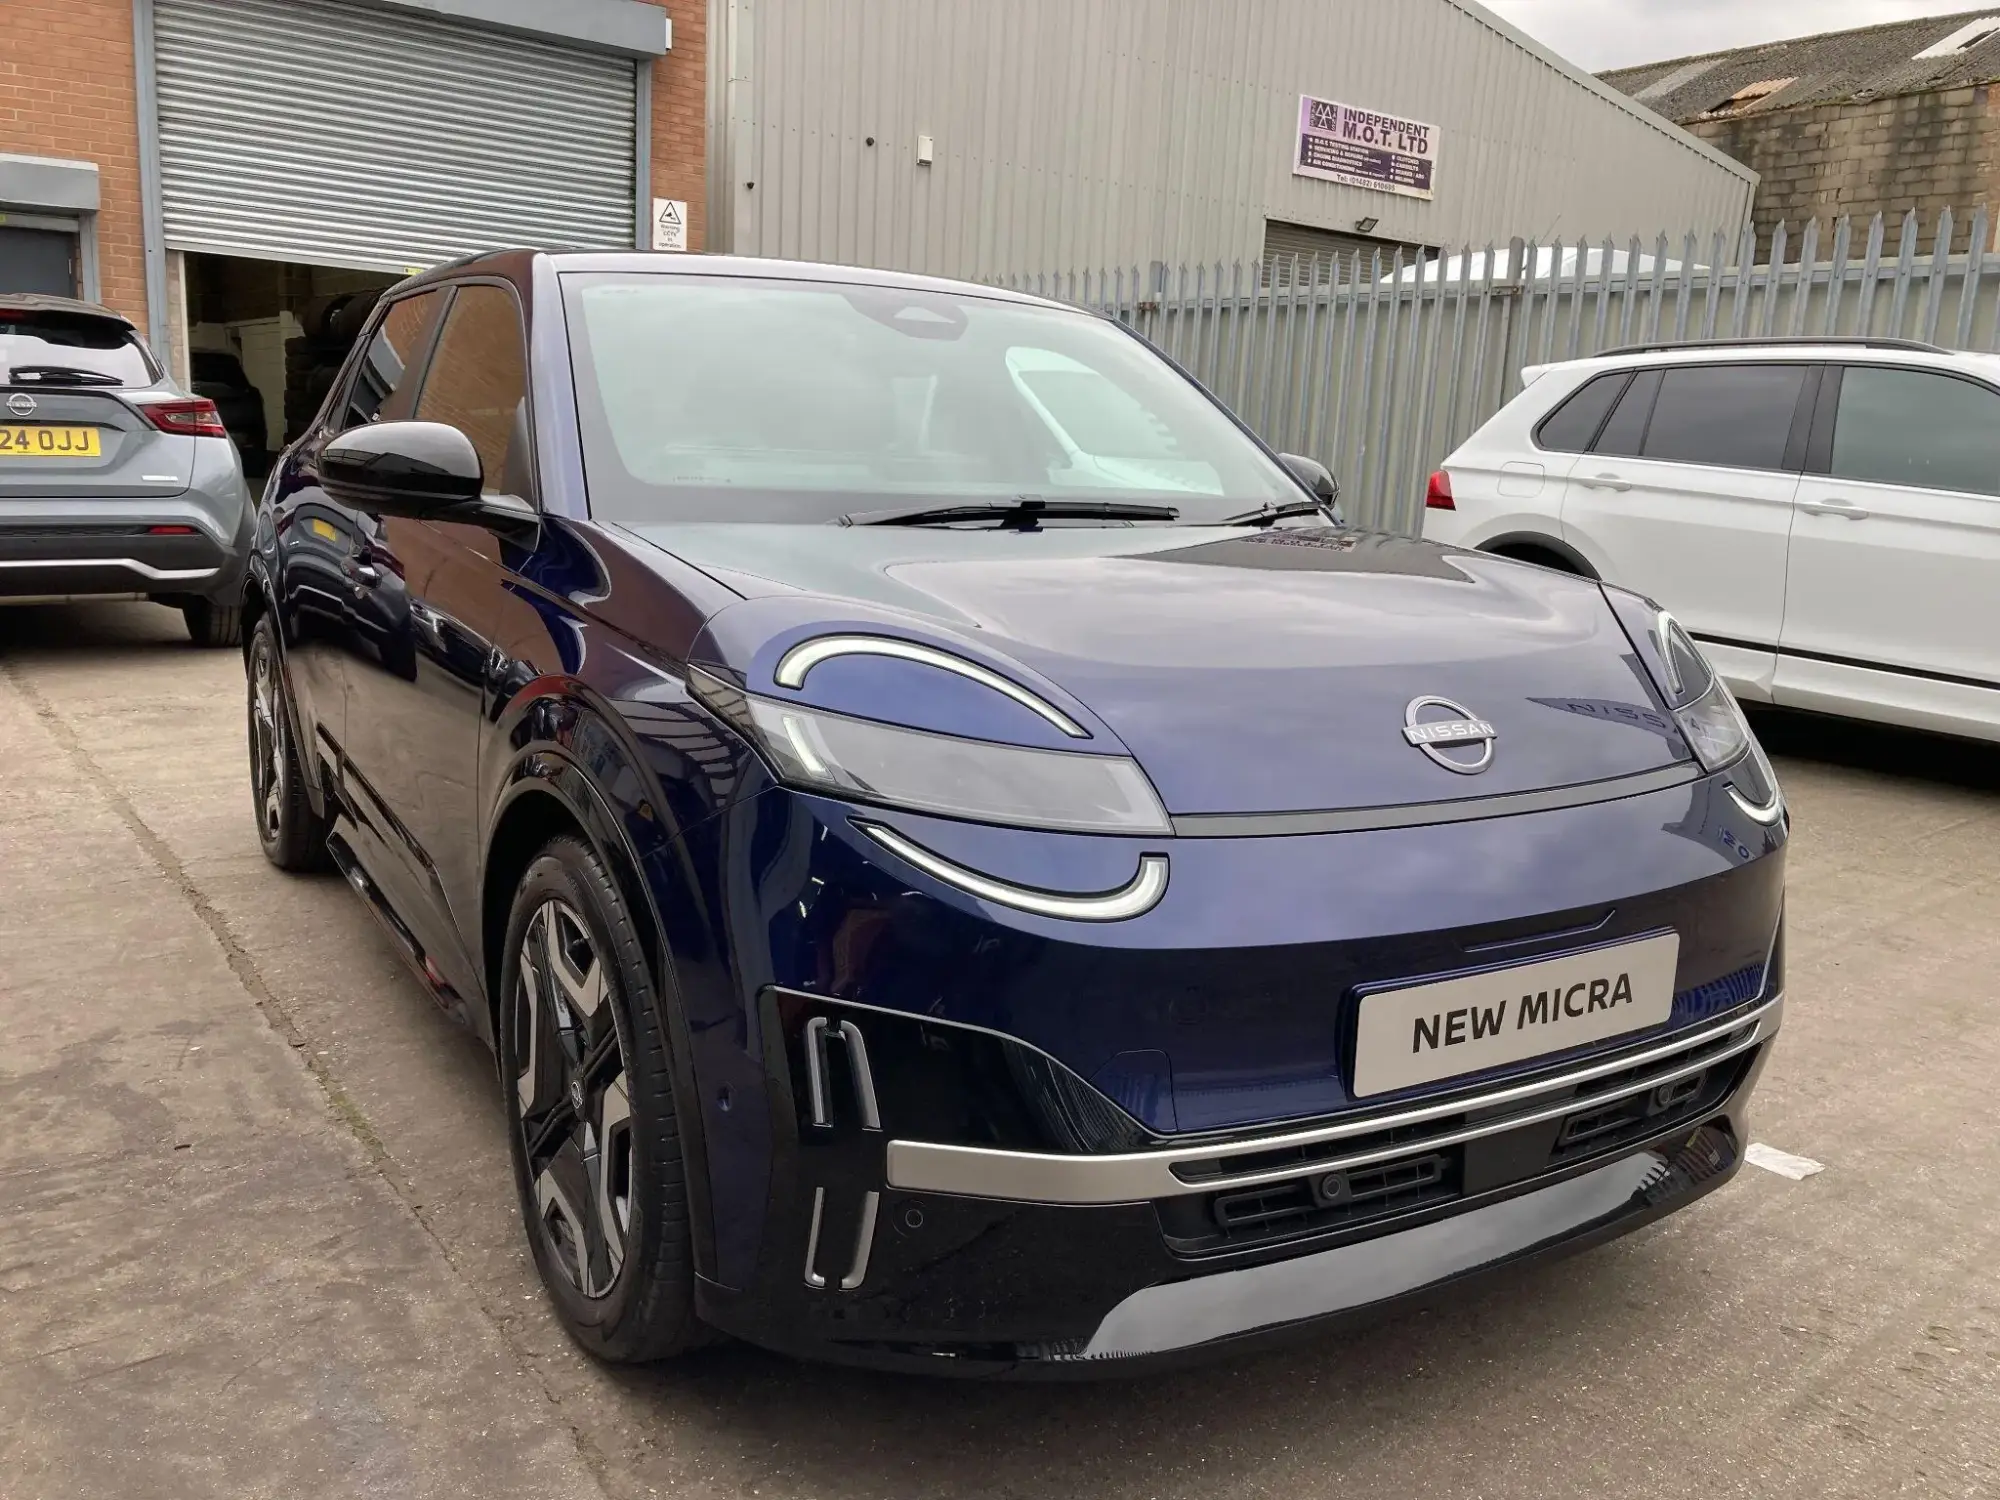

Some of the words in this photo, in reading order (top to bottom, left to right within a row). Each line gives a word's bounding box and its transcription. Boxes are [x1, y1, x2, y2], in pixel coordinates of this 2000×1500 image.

[1343, 122, 1391, 147] M.O.T.
[1398, 133, 1428, 154] LTD
[1344, 108, 1429, 138] INDEPENDENT
[0, 429, 30, 450] 24
[38, 430, 89, 450] OJJ
[1409, 723, 1495, 741] NISSAN
[1412, 1000, 1506, 1053] NEW
[1517, 973, 1633, 1030] MICRA
